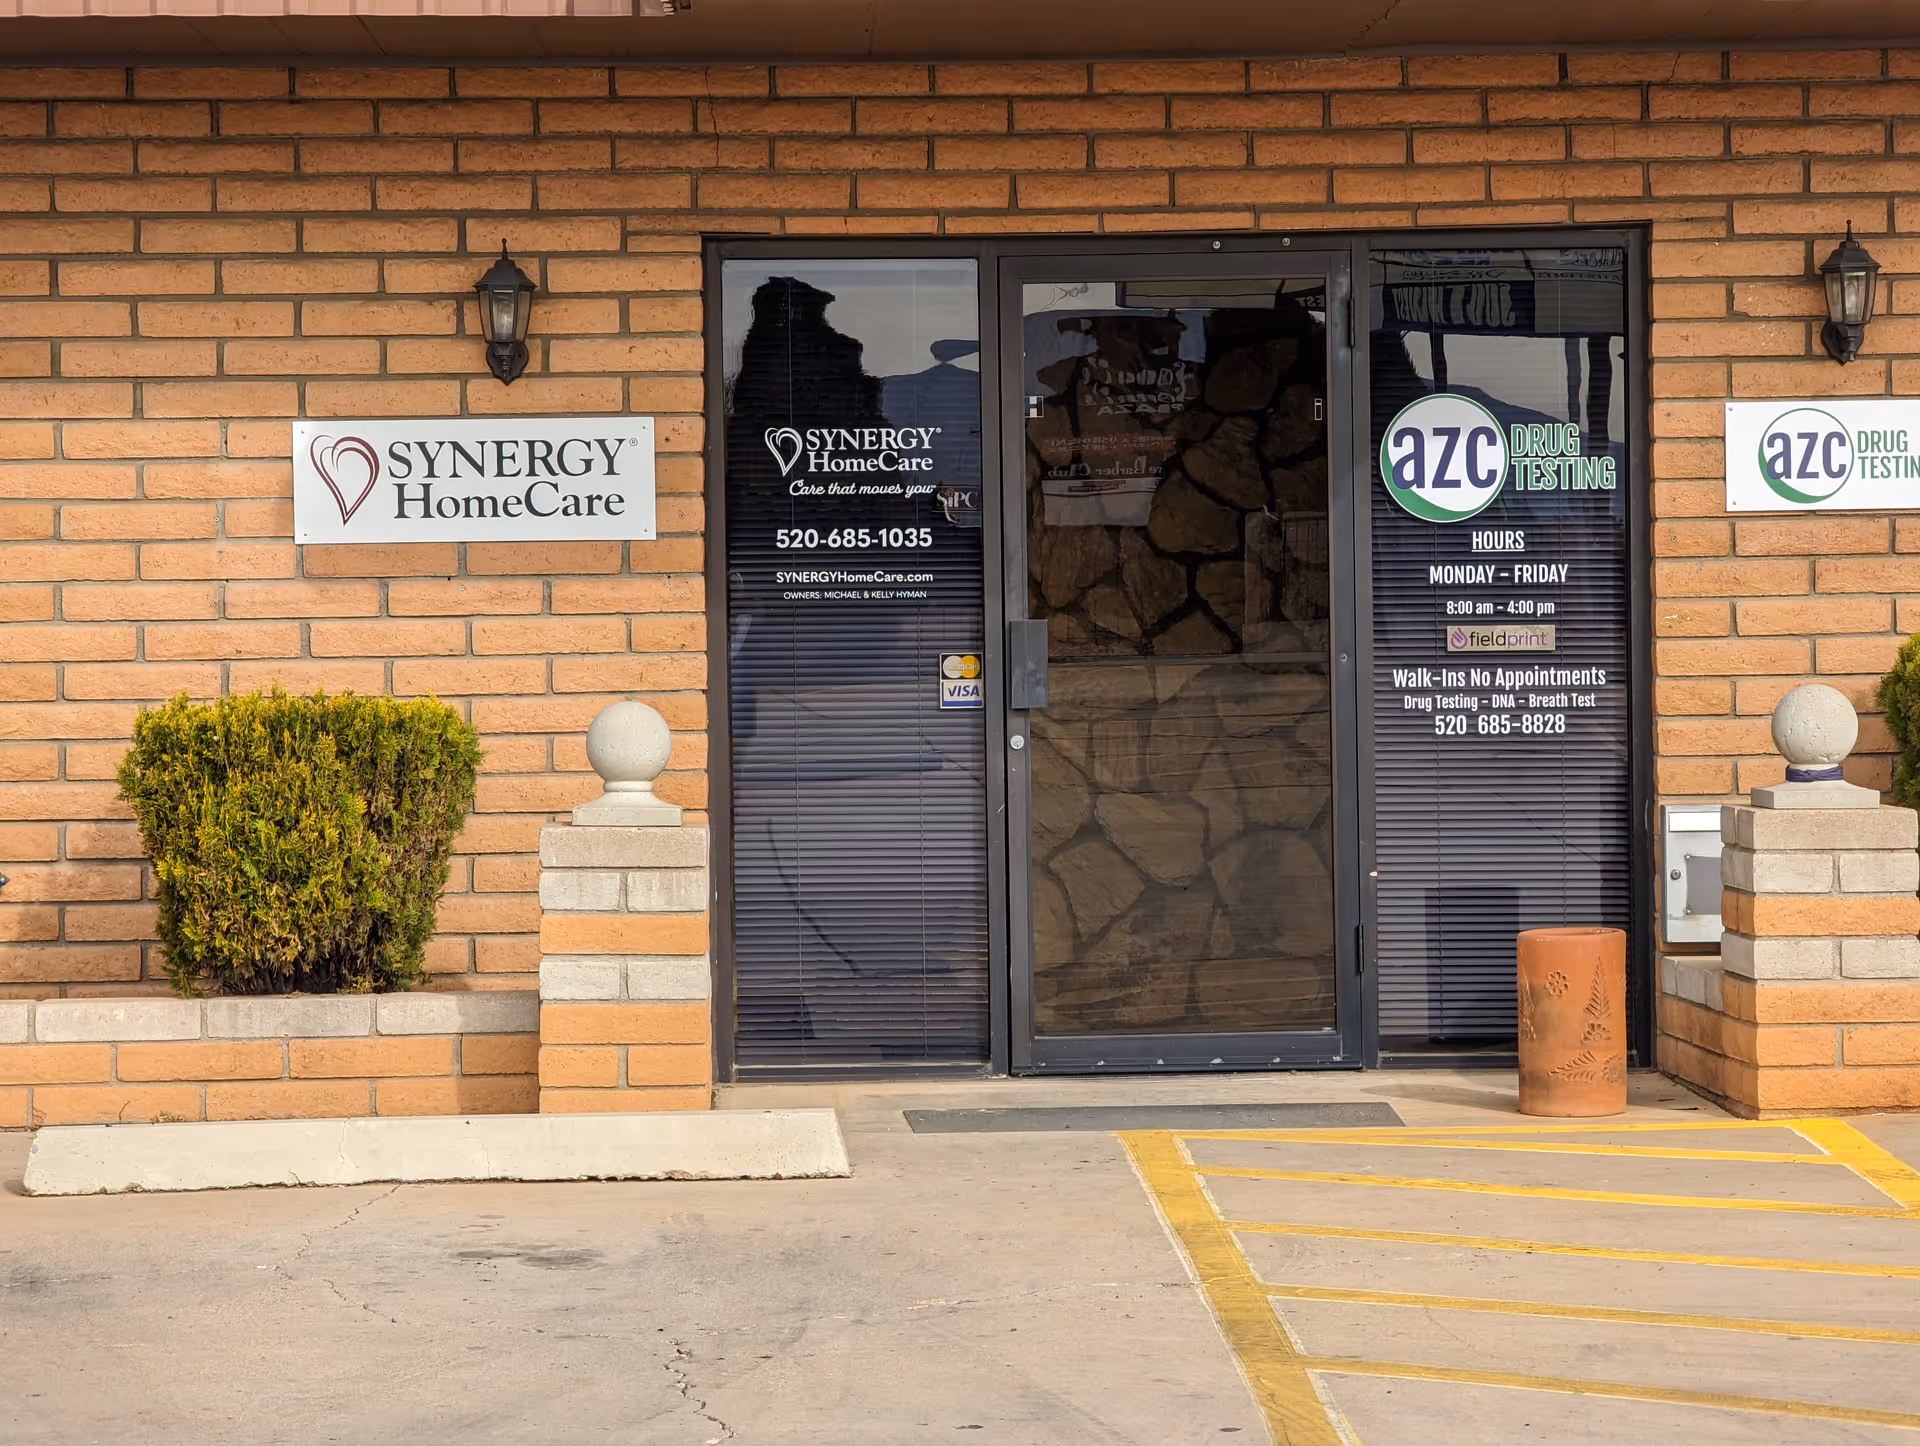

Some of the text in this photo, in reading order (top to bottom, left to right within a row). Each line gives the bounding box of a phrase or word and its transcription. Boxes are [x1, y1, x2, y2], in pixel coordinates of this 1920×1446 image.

[1511, 423, 1580, 457] DRUG
[1858, 430, 1908, 453] DRUG
[807, 451, 933, 472] HomeCare
[1392, 426, 1497, 489] azc
[1766, 431, 1846, 480] azc
[1511, 456, 1616, 490] TESTING
[789, 480, 825, 497] Care
[828, 481, 857, 495] that
[859, 484, 903, 495] moves
[393, 480, 626, 520] HomeCare
[776, 528, 933, 549] 520-685-1035
[1472, 531, 1525, 551] HOURS
[776, 571, 933, 584] SYNERGYHomeCare.com
[1429, 565, 1495, 584] MONDAY
[1514, 564, 1568, 583] FRIDAY
[783, 590, 927, 600] OWNERS: MICHAEL & KELLY HYMAN
[1446, 601, 1473, 615] 8:00
[1476, 603, 1493, 614] am
[1507, 601, 1533, 614] 4:00
[1537, 603, 1555, 617] pm
[1469, 631, 1548, 649] fieldprint
[1393, 666, 1606, 690] Walk-Ins No Appointments
[948, 685, 980, 697] VISA
[1404, 695, 1432, 711] Drug
[1435, 694, 1478, 711] Testing
[1492, 695, 1515, 708] DNA
[1529, 694, 1568, 708] Breath
[1571, 693, 1596, 708] Test
[1435, 714, 1566, 735] 520 685-8828
